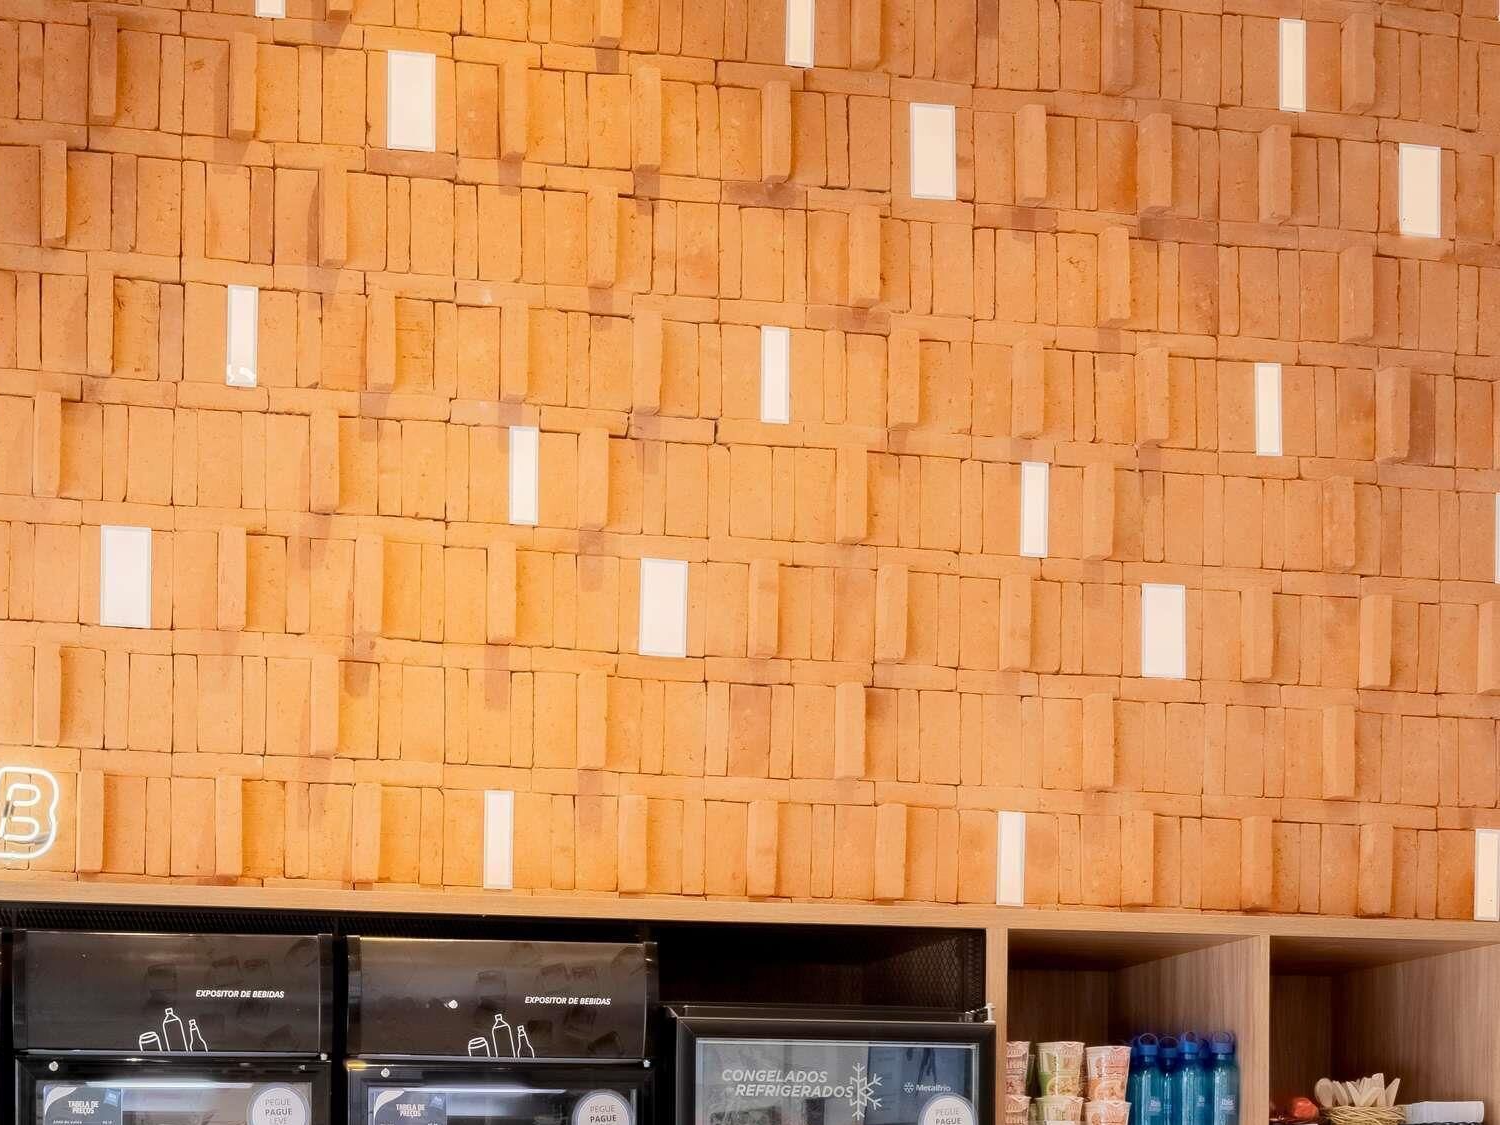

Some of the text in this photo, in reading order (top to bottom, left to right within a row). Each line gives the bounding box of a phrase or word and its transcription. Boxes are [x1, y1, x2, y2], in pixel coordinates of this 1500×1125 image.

[196, 989, 284, 999] EXPOSITOR DE BEBIDAS
[524, 996, 611, 1005] EXPOSITOR DE BEBIDAS
[722, 1069, 828, 1083] CONGELADOS
[735, 1084, 854, 1098] REFRIGERADOS
[915, 1084, 952, 1092] Metalfrio
[68, 1100, 100, 1108] TABELA DE
[265, 1108, 292, 1116] PAGUE
[590, 1105, 615, 1113] PEGUE
[590, 1114, 617, 1122] PAGUE
